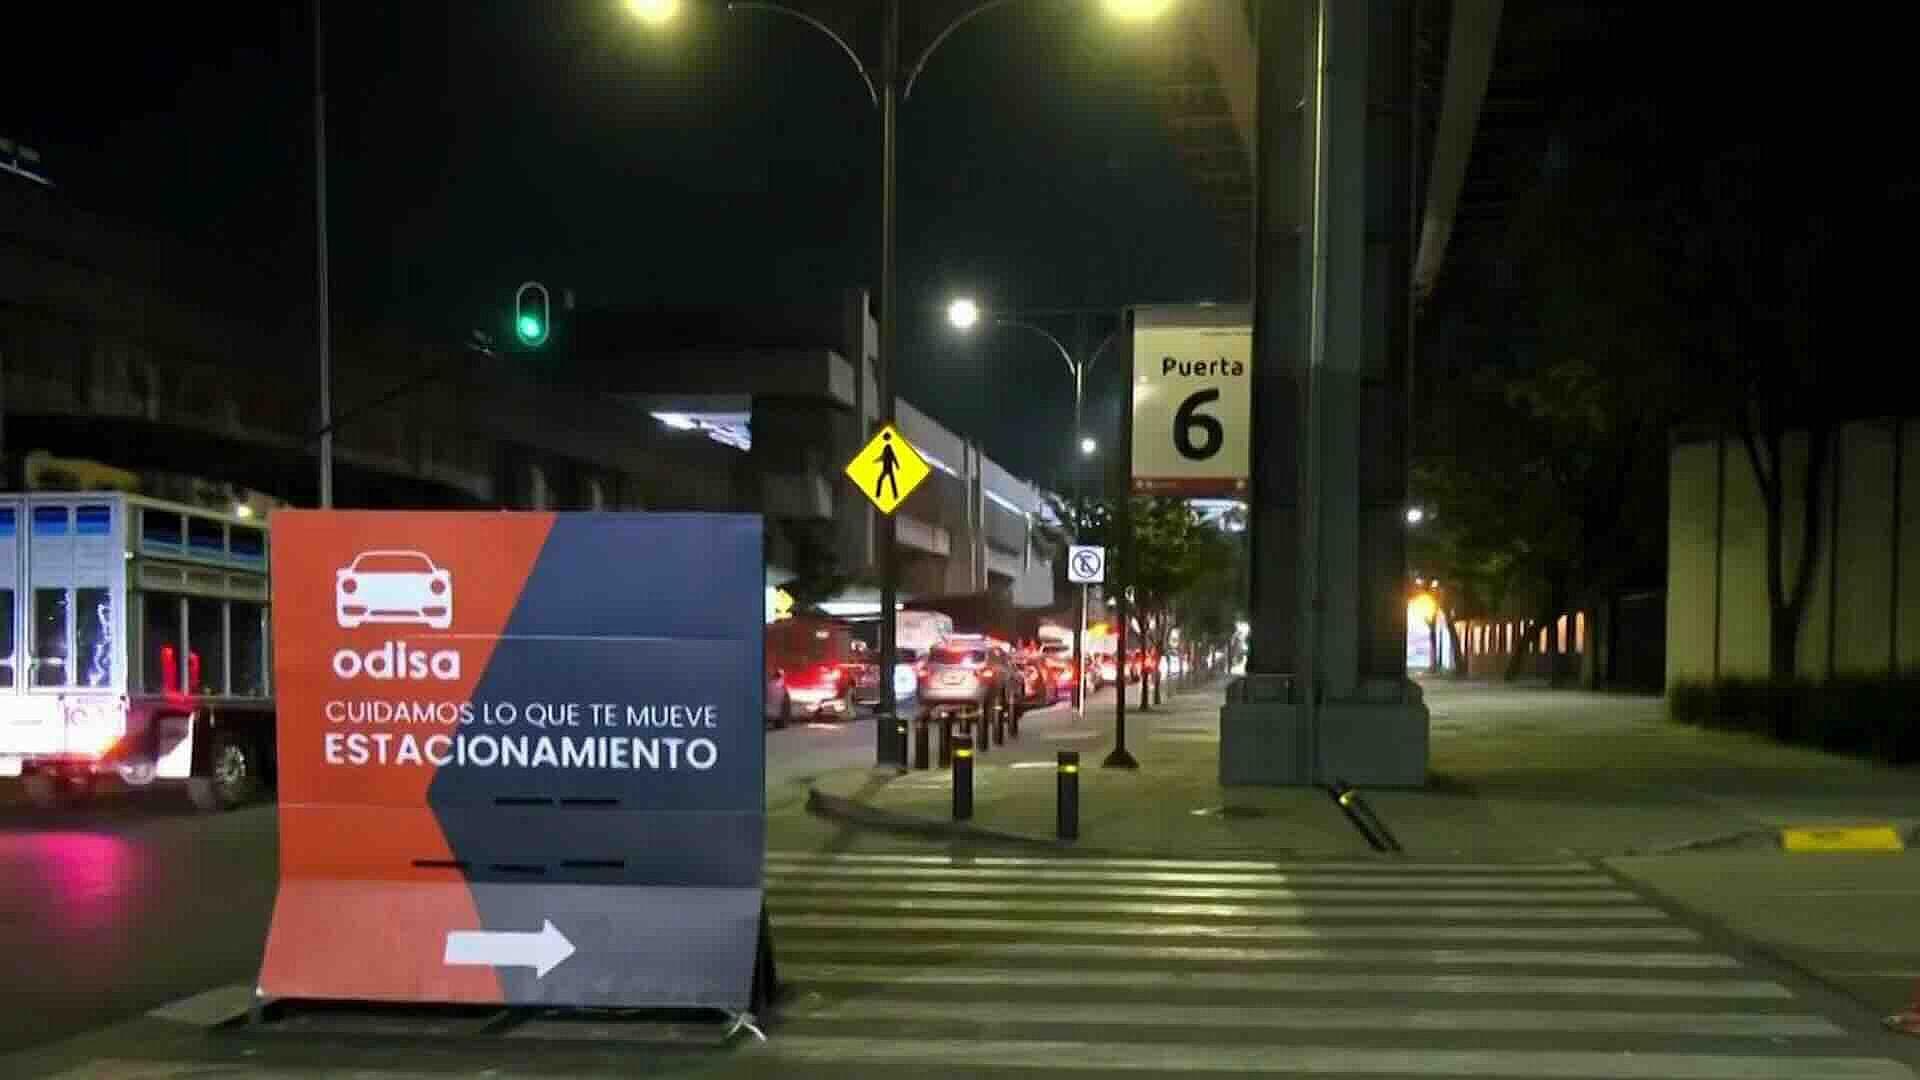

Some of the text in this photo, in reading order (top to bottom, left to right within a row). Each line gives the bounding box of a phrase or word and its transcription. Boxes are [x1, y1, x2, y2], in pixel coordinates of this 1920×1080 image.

[1162, 357, 1244, 377] Puerta
[1173, 387, 1224, 462] 6
[332, 640, 461, 681] odisa
[325, 701, 718, 729] CUIDAMOS LO QUE TE MUEVE
[324, 732, 718, 770] ESTACIONAMIENTO
